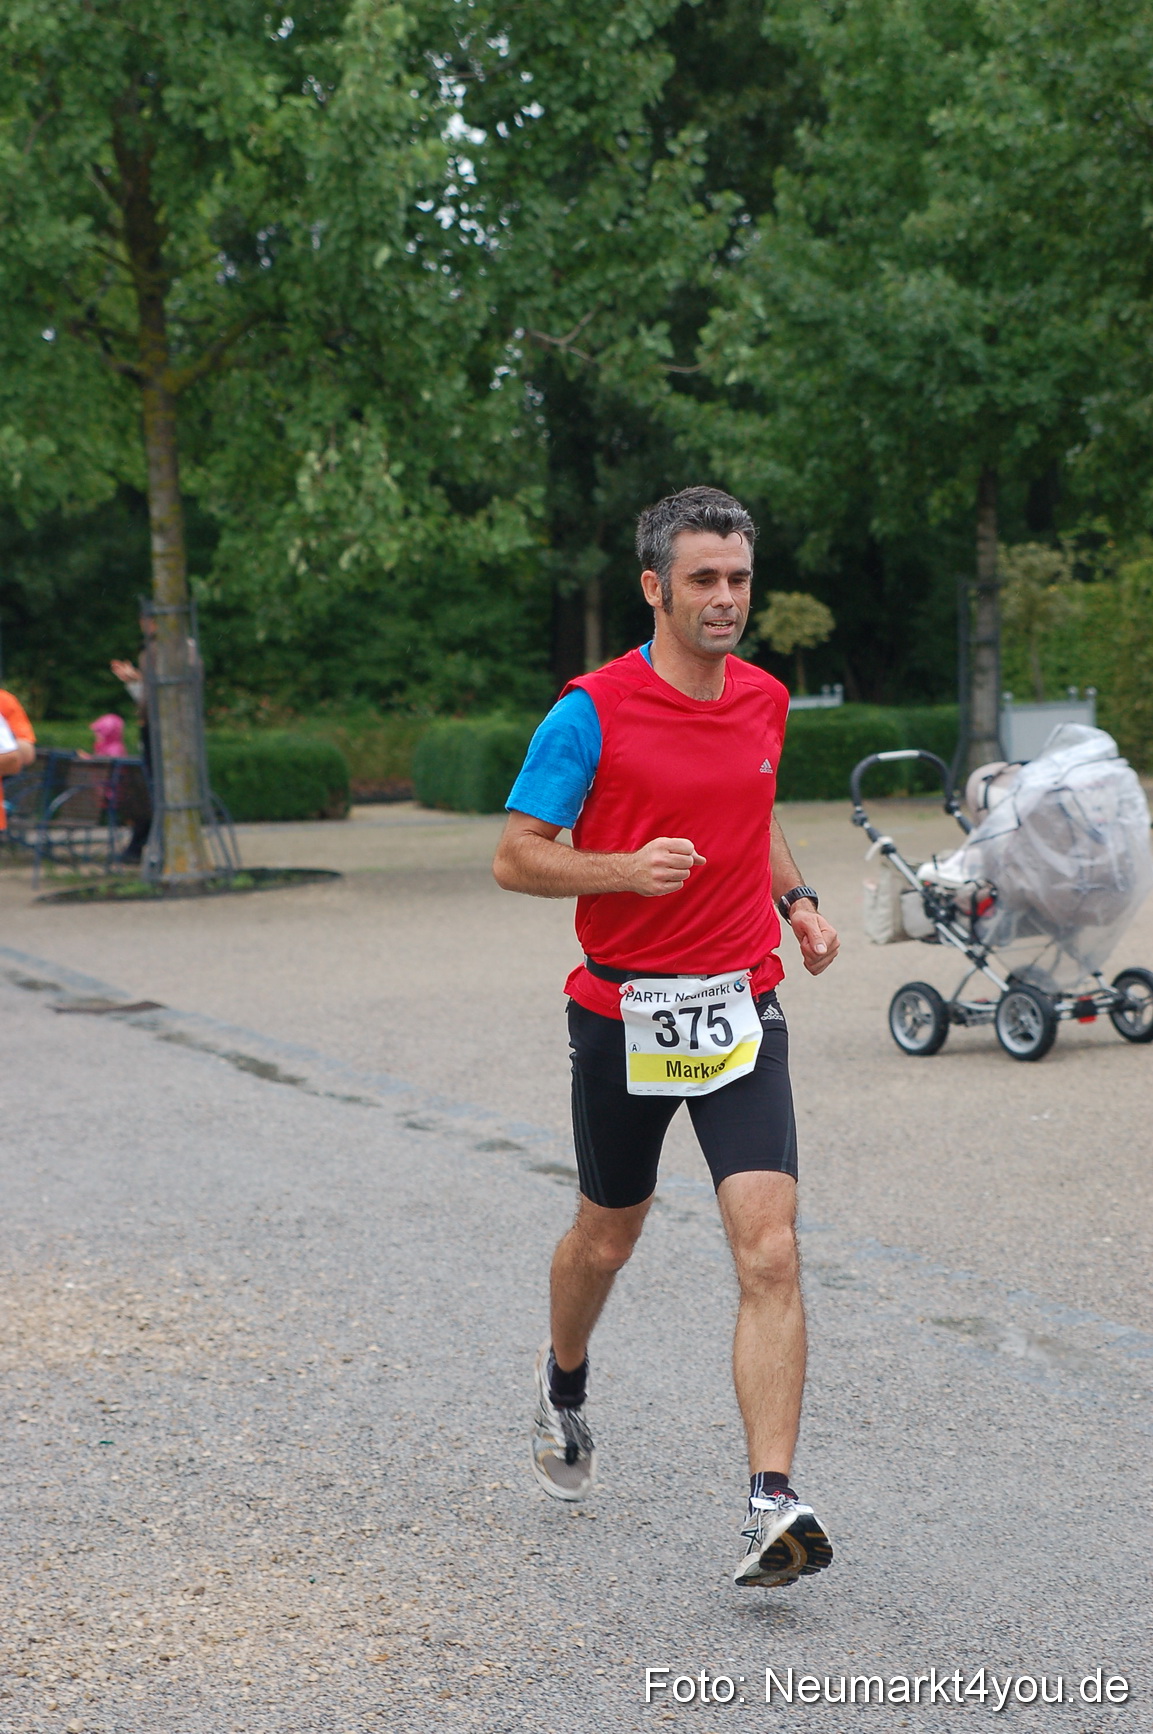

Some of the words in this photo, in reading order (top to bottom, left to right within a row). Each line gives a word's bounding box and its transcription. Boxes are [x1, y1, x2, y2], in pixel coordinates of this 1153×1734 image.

[625, 989, 671, 1003] PARTL
[652, 1002, 734, 1050] 375
[631, 1043, 638, 1052] A
